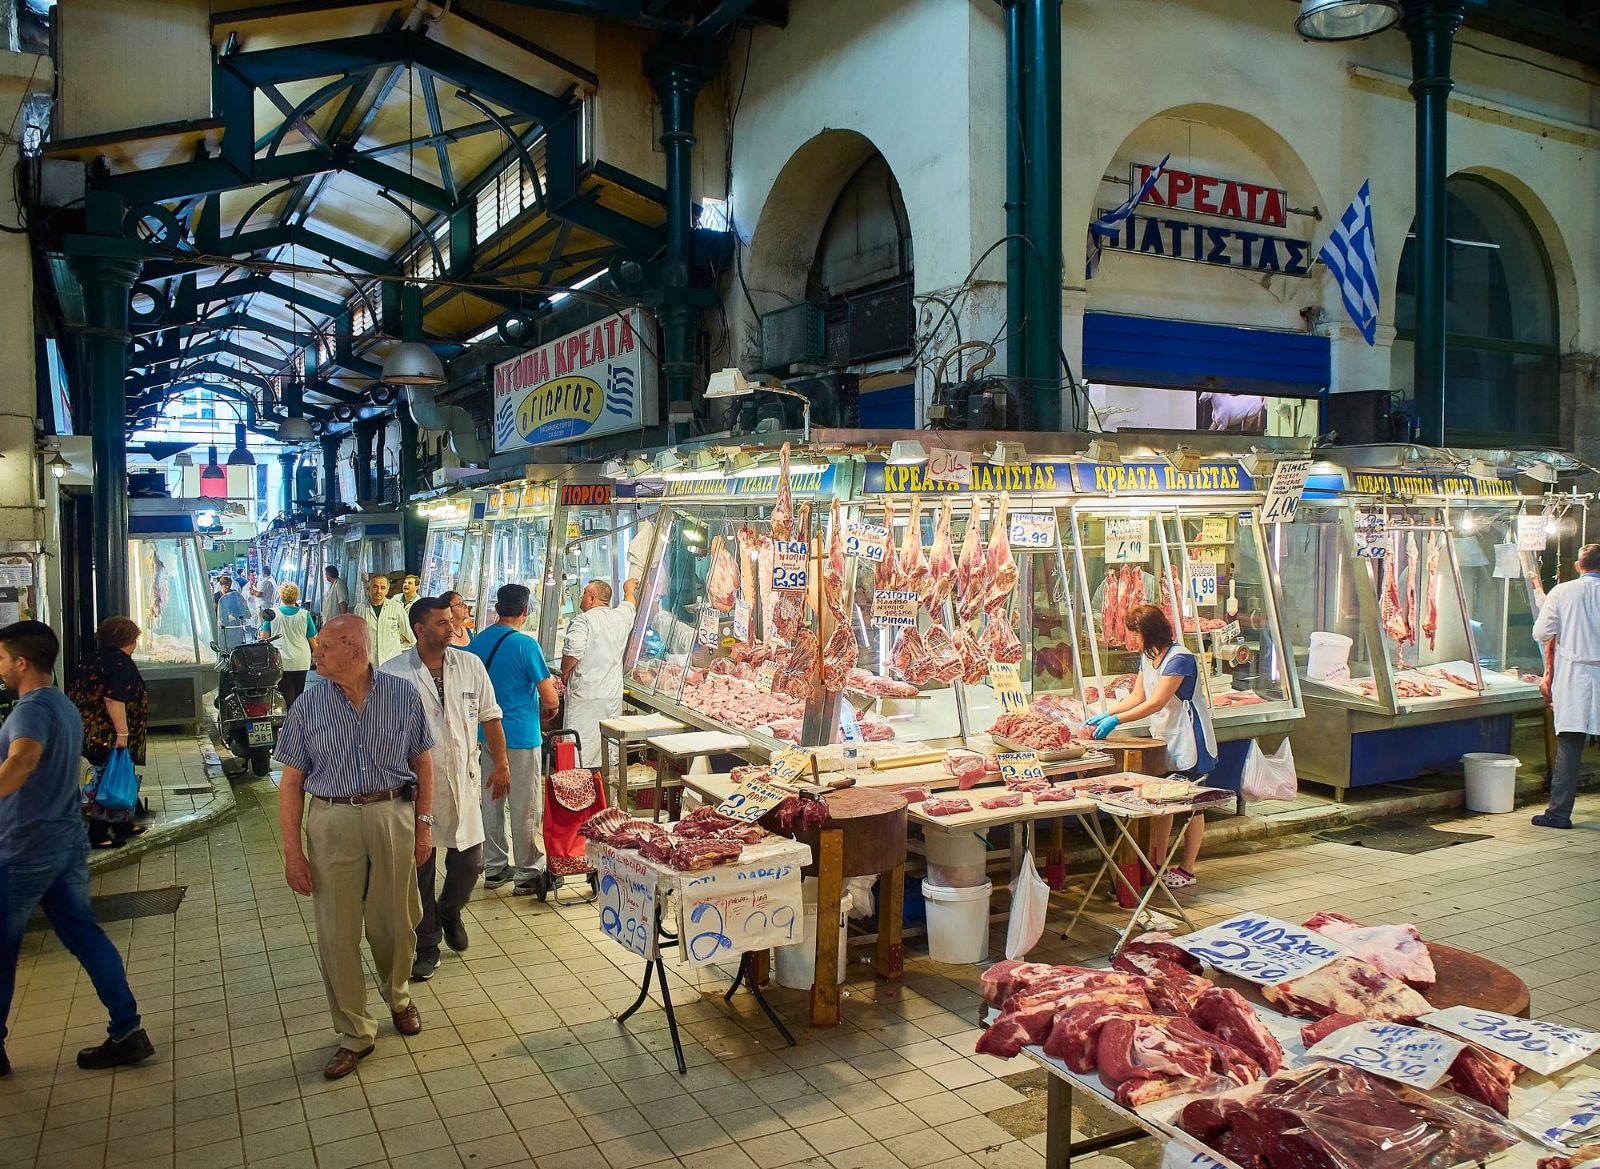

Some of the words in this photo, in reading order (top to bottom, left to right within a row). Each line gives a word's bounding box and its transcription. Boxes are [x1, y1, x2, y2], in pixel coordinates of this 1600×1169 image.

[1140, 165, 1285, 225] ΚΡΕΑΤΑ
[496, 348, 550, 398] ΝΤΟΠΙΑ
[555, 314, 634, 378] ΚΡΕΑΤΑ
[530, 383, 593, 423] ΓΙΩΡΓΟΣ
[932, 454, 967, 475] حلال
[1094, 466, 1157, 489] ΚΡΕΑΤΑ
[1356, 475, 1391, 494] ΚΡΕΑΤΑ
[1393, 476, 1435, 496] ΠΑΤΙΣΤΑΣ
[1443, 478, 1476, 496] ΚΡΕΑΤΑ
[847, 536, 882, 560] 2.99
[772, 567, 806, 588] 2.99
[876, 590, 918, 601] ΖΥΓΟΥΡΙ
[874, 616, 914, 625] ΤΡΙΠΟΛΗ
[255, 733, 272, 742] 381
